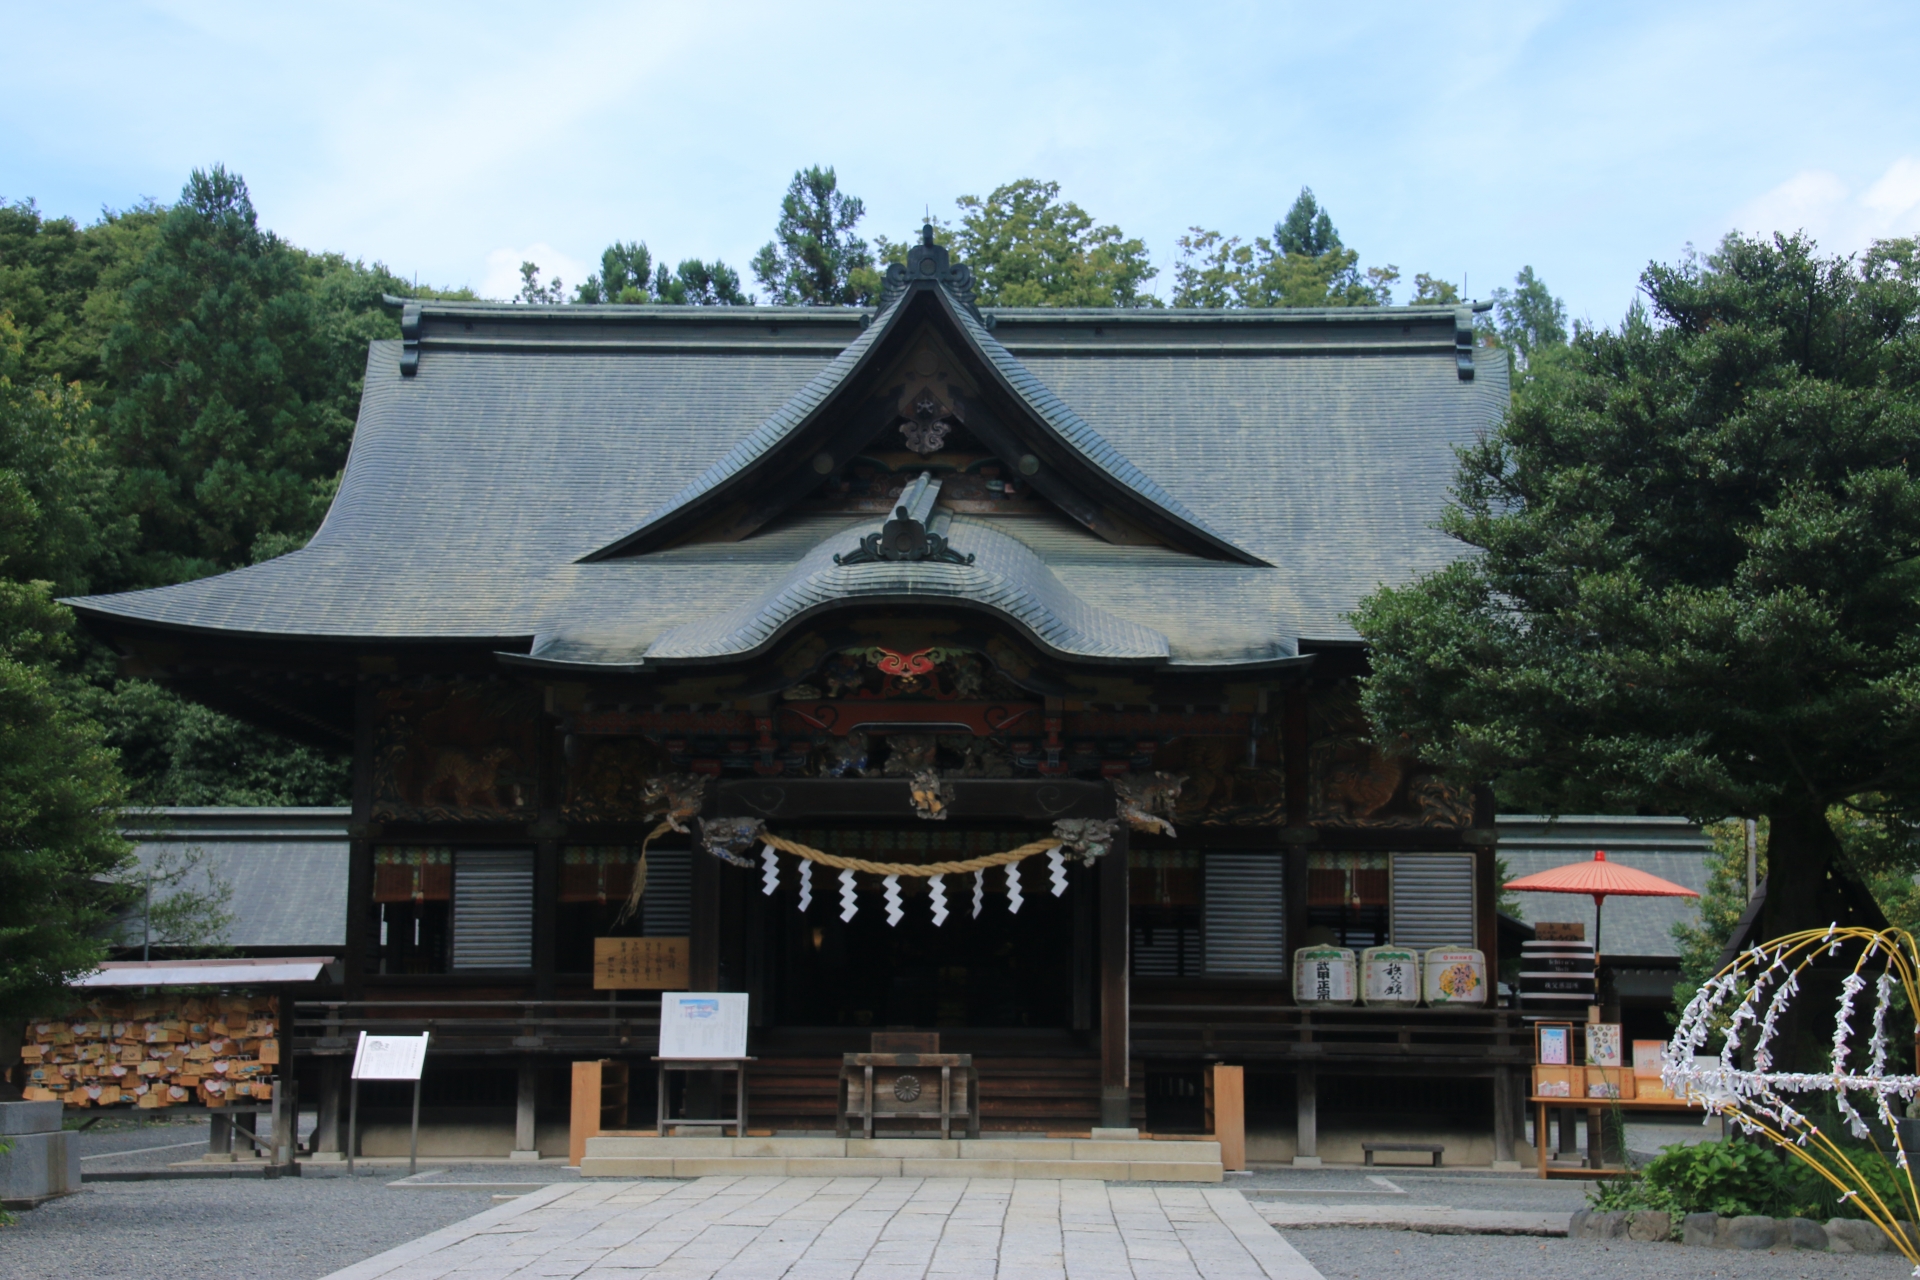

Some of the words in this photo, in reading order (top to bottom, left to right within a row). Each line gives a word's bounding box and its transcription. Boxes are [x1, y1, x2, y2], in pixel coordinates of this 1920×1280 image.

[1317, 961, 1330, 1000] 武甲正宗
[1382, 963, 1402, 998] 秩父錦
